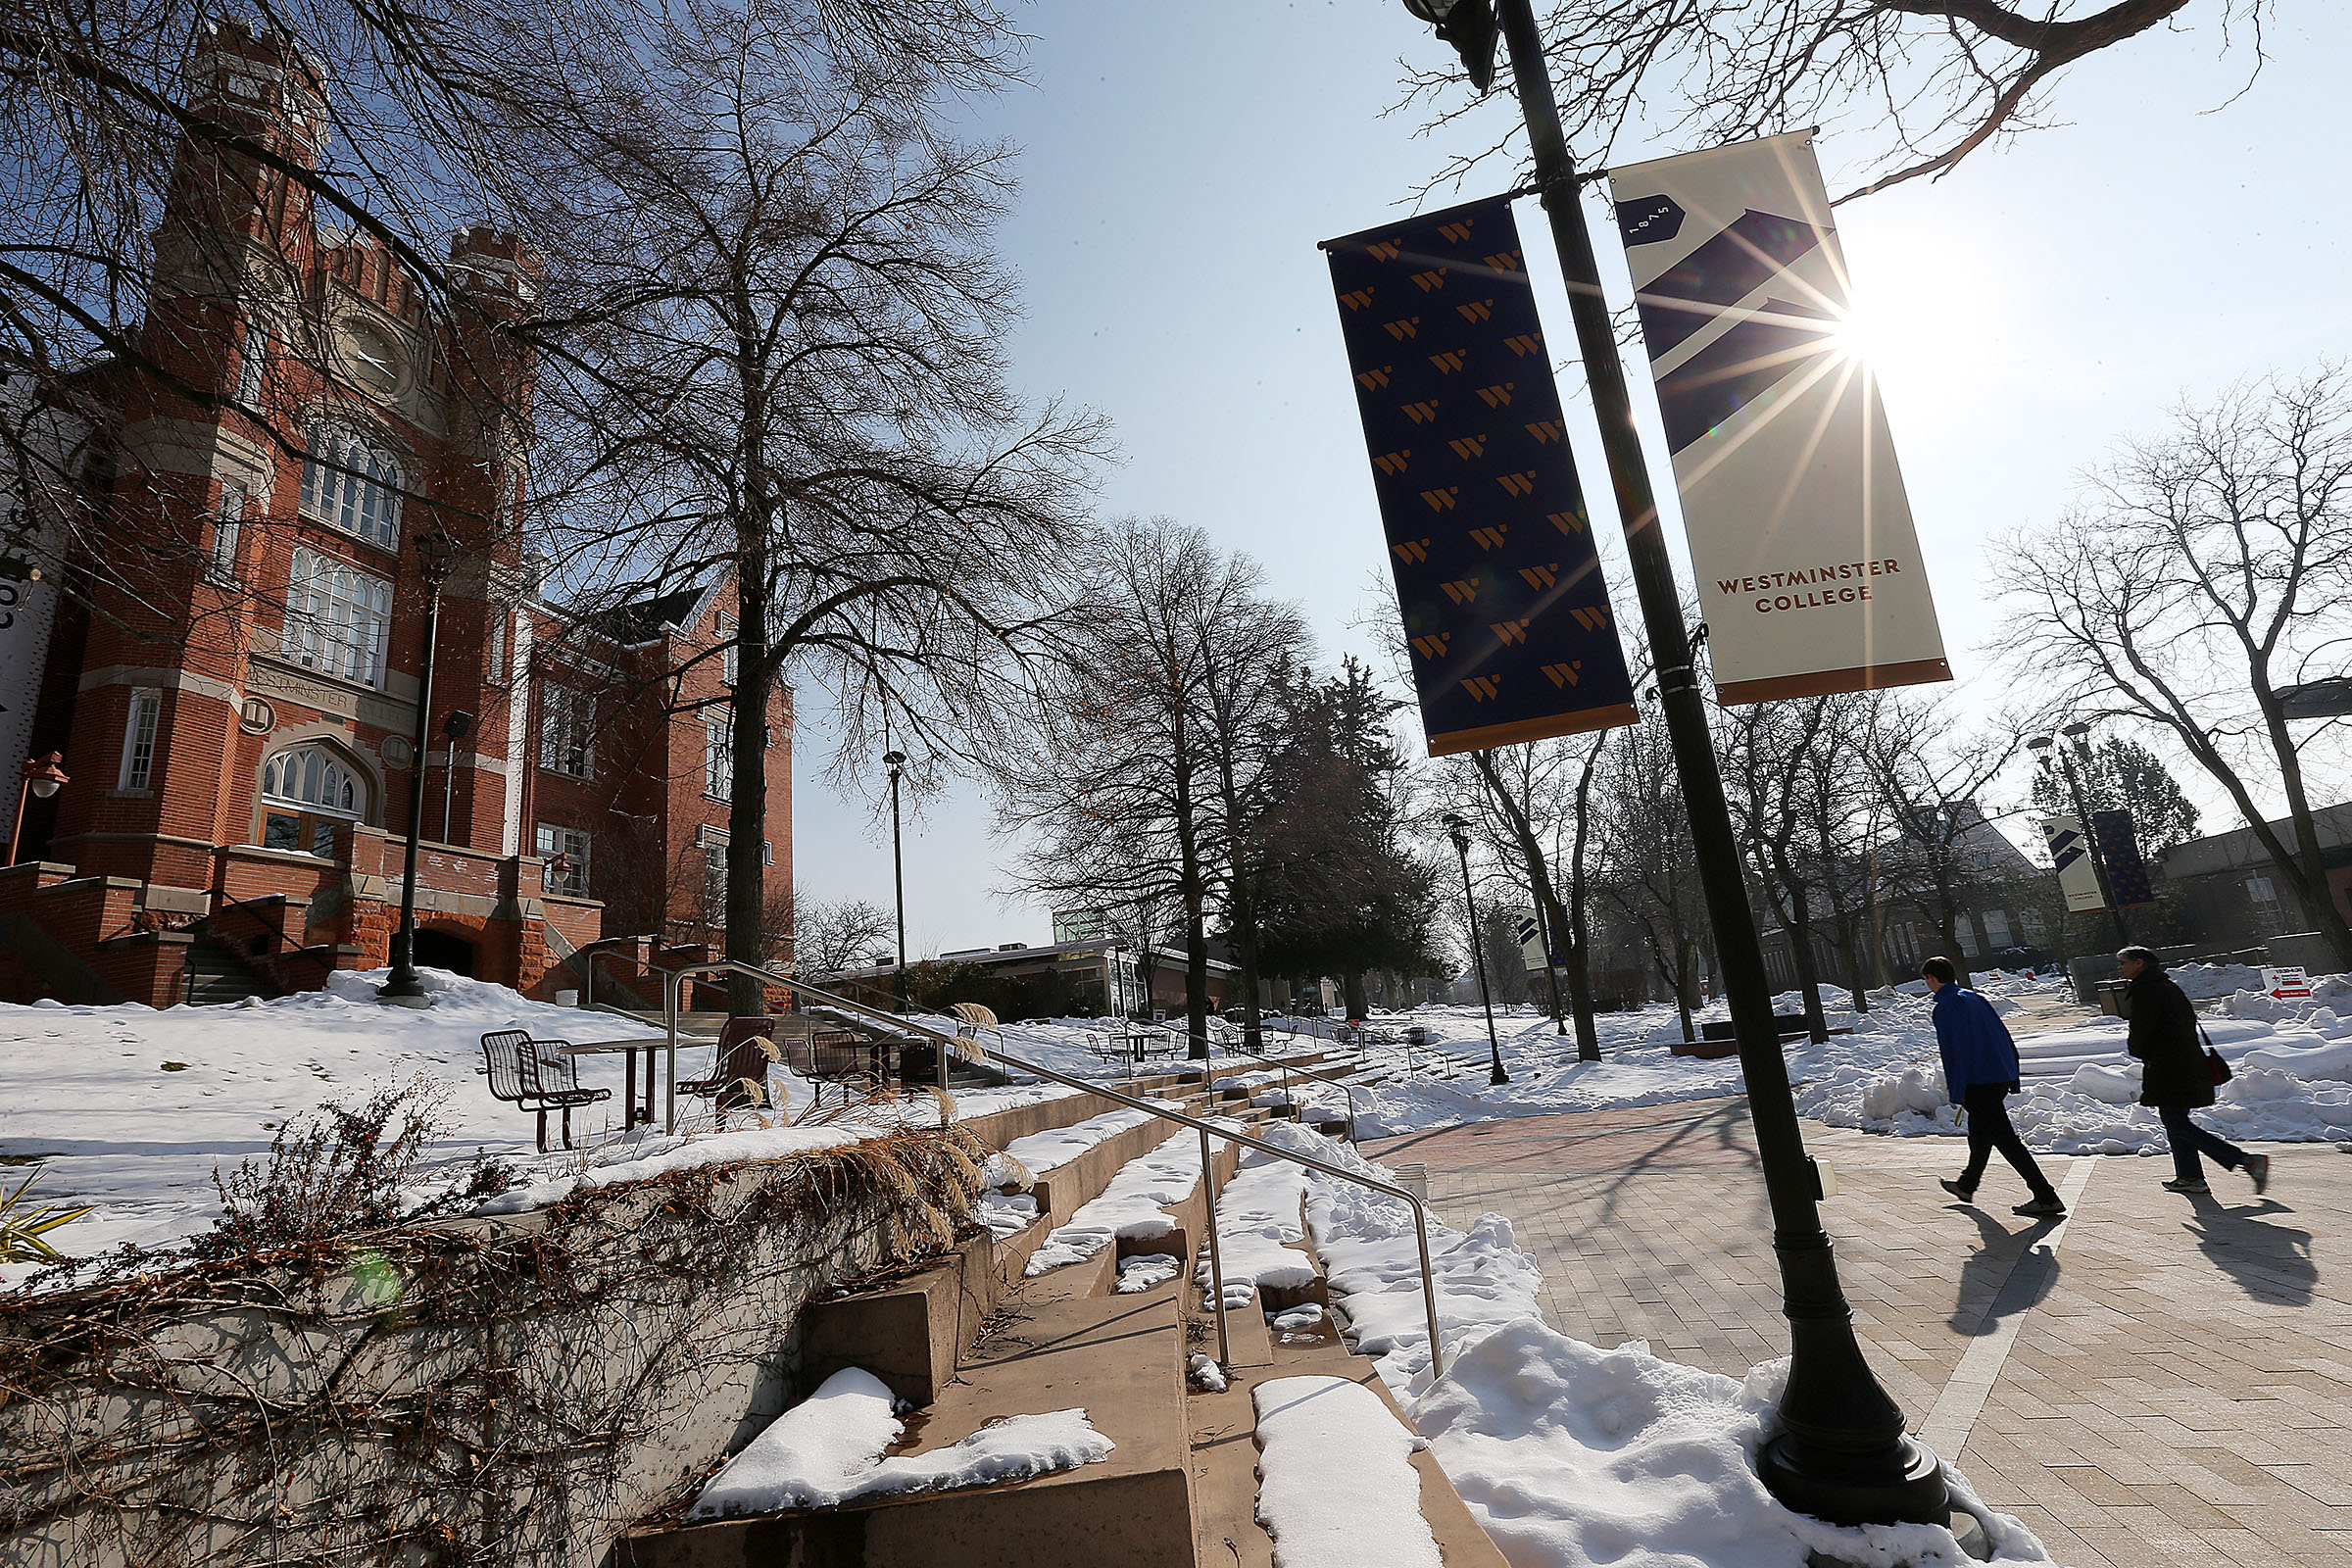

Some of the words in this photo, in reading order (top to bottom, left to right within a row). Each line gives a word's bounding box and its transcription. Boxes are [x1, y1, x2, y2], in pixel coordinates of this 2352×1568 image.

[1628, 206, 1670, 234] 1875
[1717, 559, 1901, 595] WESTMINSTER
[1755, 585, 1873, 613] COLLEGE
